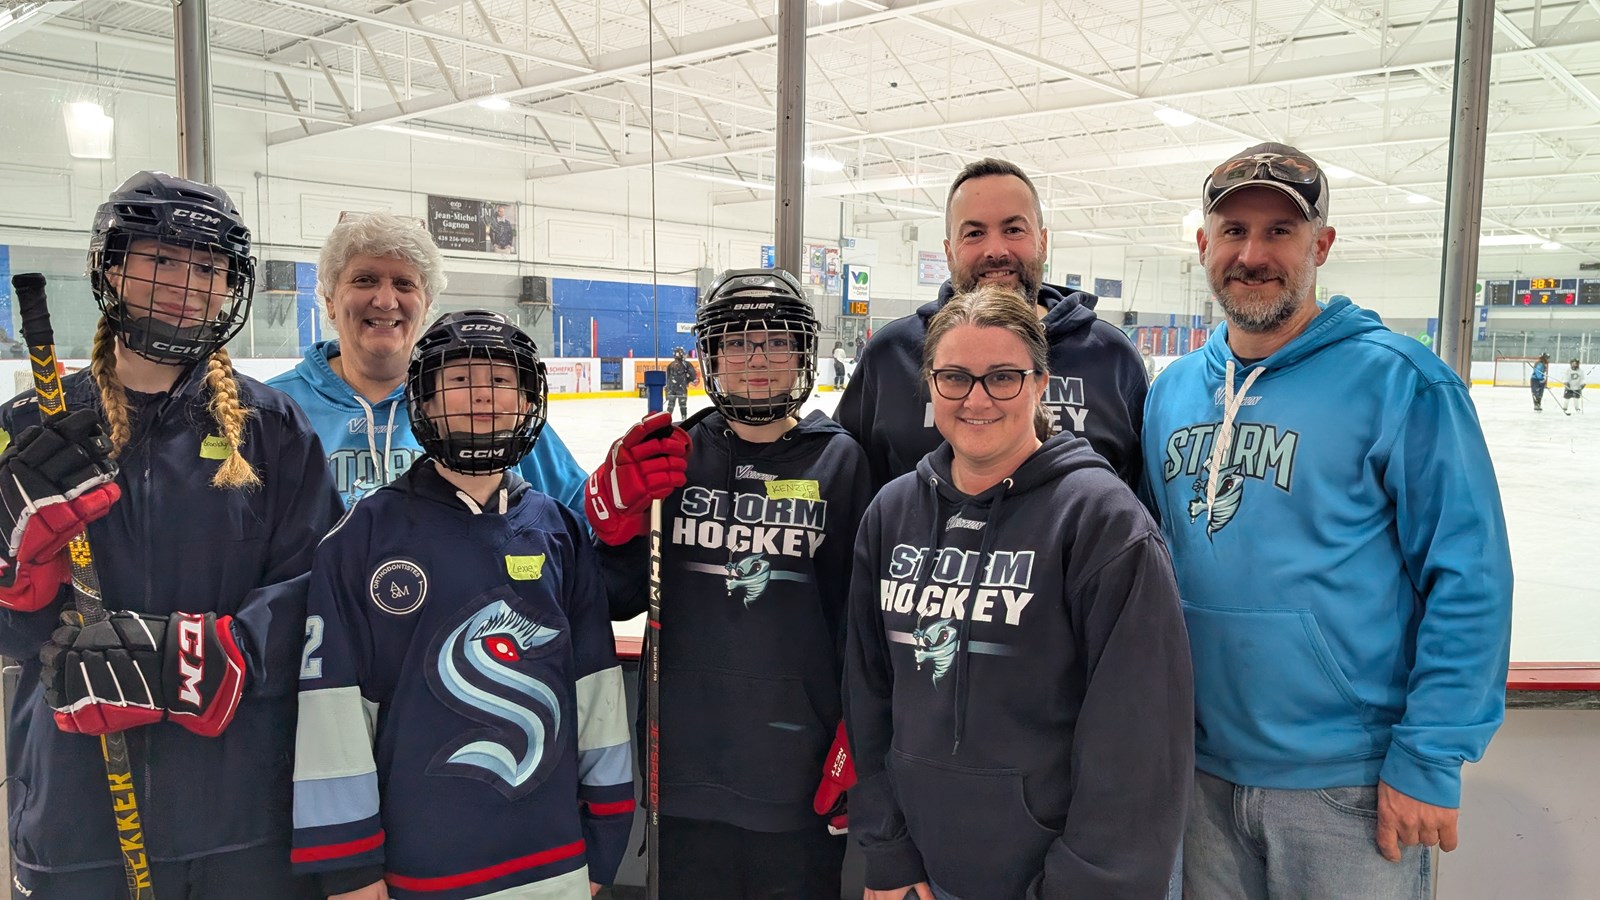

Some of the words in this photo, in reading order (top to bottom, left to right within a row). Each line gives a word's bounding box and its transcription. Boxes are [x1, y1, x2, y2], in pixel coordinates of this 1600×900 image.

[173, 208, 221, 225] CCM
[434, 211, 477, 222] Jean-Michel
[442, 220, 470, 229] Gagnon
[460, 324, 503, 332] CCM
[329, 448, 426, 493] TOR
[459, 448, 504, 459] CCM
[680, 486, 828, 531] STORM
[672, 516, 826, 558] HOCKEY
[373, 563, 421, 589] ORTHODONTISTES
[889, 543, 1035, 590] STORM
[880, 578, 1035, 626] HOCKEY
[650, 719, 659, 804] JETSPEED
[107, 771, 151, 889] REKKER
